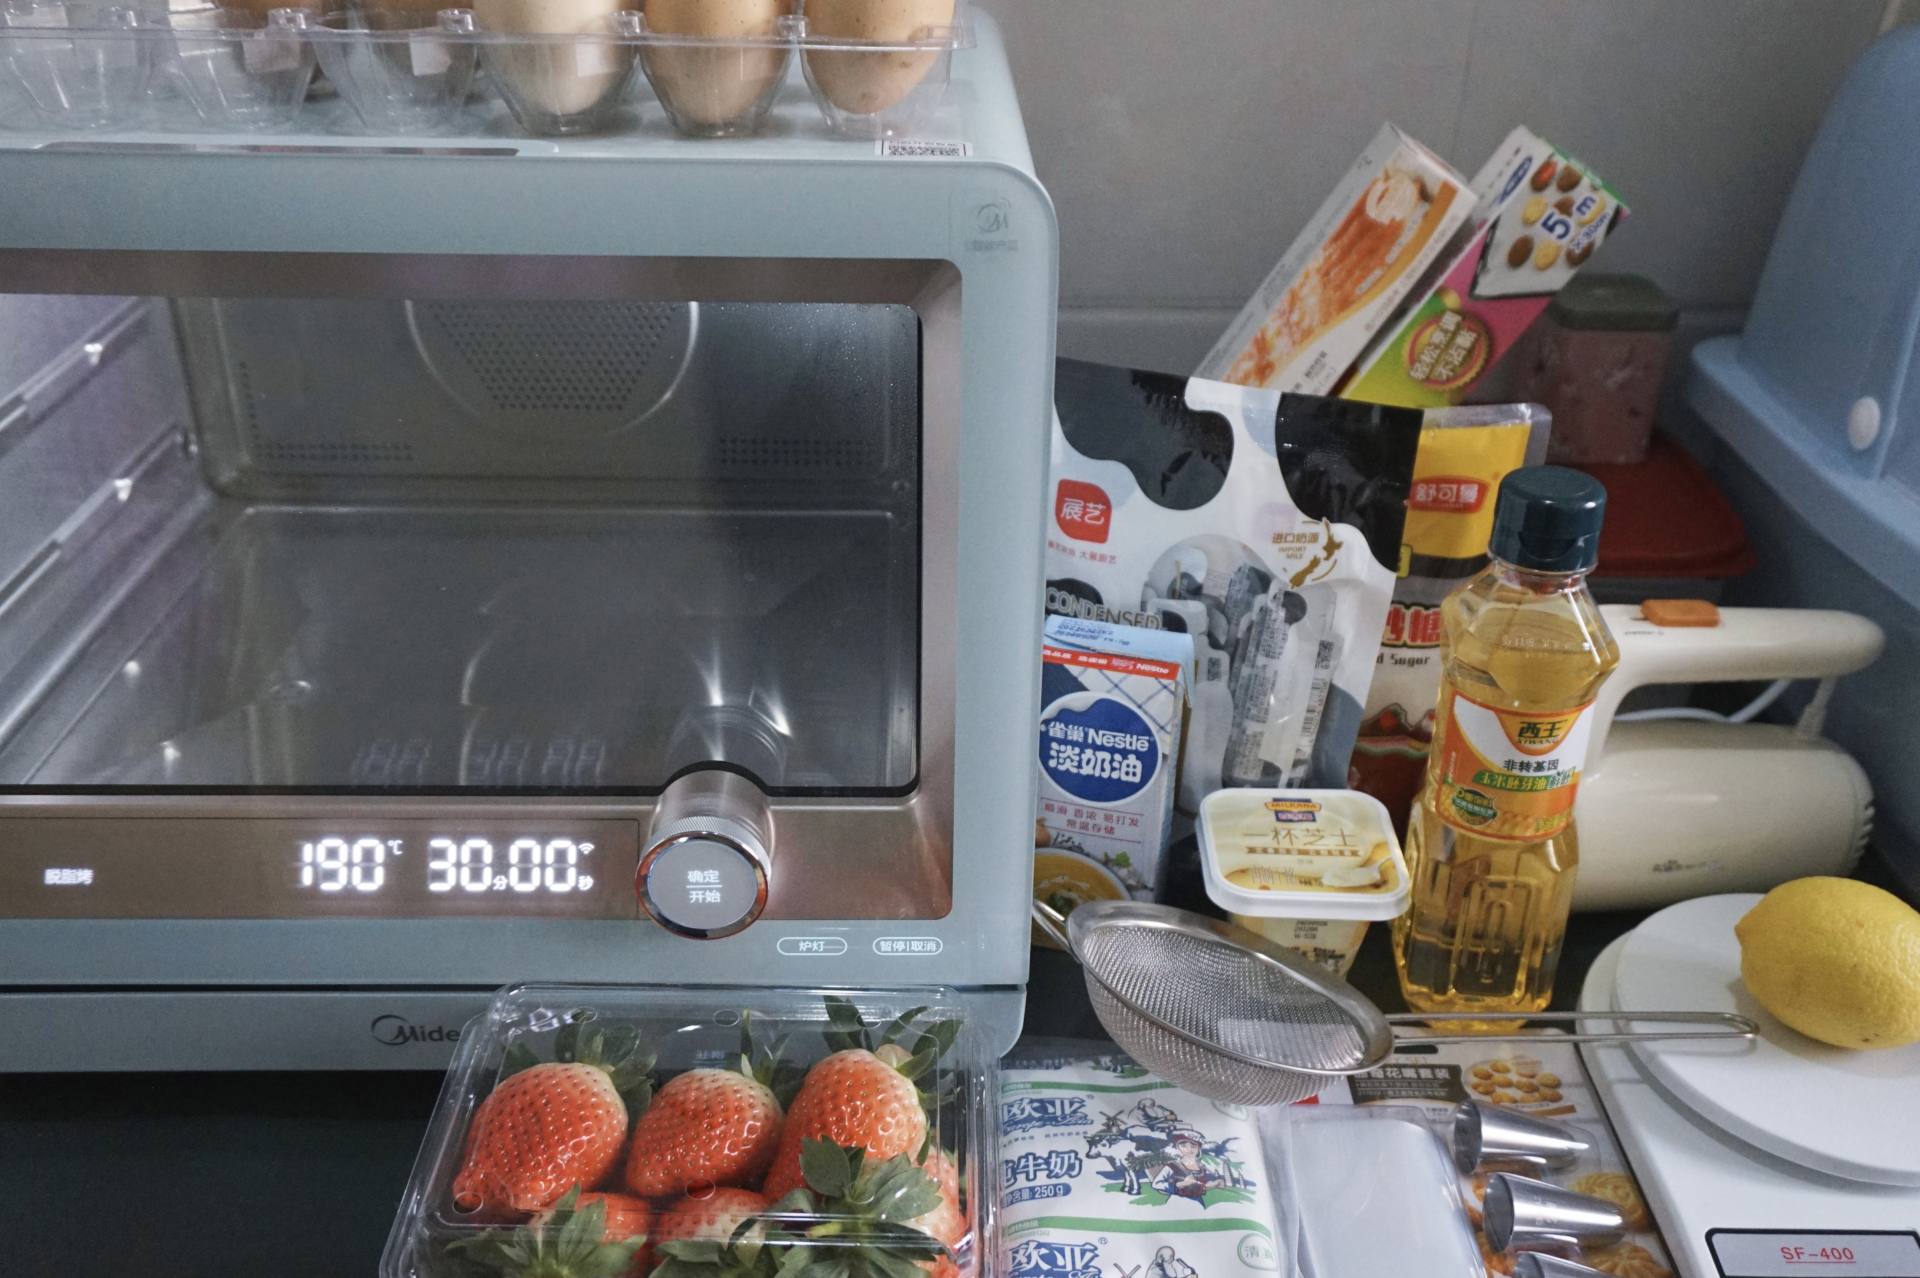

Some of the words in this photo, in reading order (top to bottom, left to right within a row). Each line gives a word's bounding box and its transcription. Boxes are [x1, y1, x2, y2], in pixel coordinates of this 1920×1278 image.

[1541, 211, 1571, 240] 5
[1061, 497, 1106, 525] 展艺
[1046, 586, 1162, 630] CONDENSED
[1048, 720, 1085, 743] 雀巢
[1517, 719, 1568, 739] 西王
[1048, 742, 1143, 784] 淡奶油
[1503, 758, 1560, 773] 非转基因
[1243, 826, 1357, 847] 一杯芝士
[687, 869, 720, 884] 确定
[689, 889, 721, 904] 开始
[798, 939, 825, 953] 炉灯
[1003, 1097, 1088, 1119] 欧亚
[1011, 1239, 1100, 1273] 欧亚
[1780, 1246, 1855, 1261] SF-400
